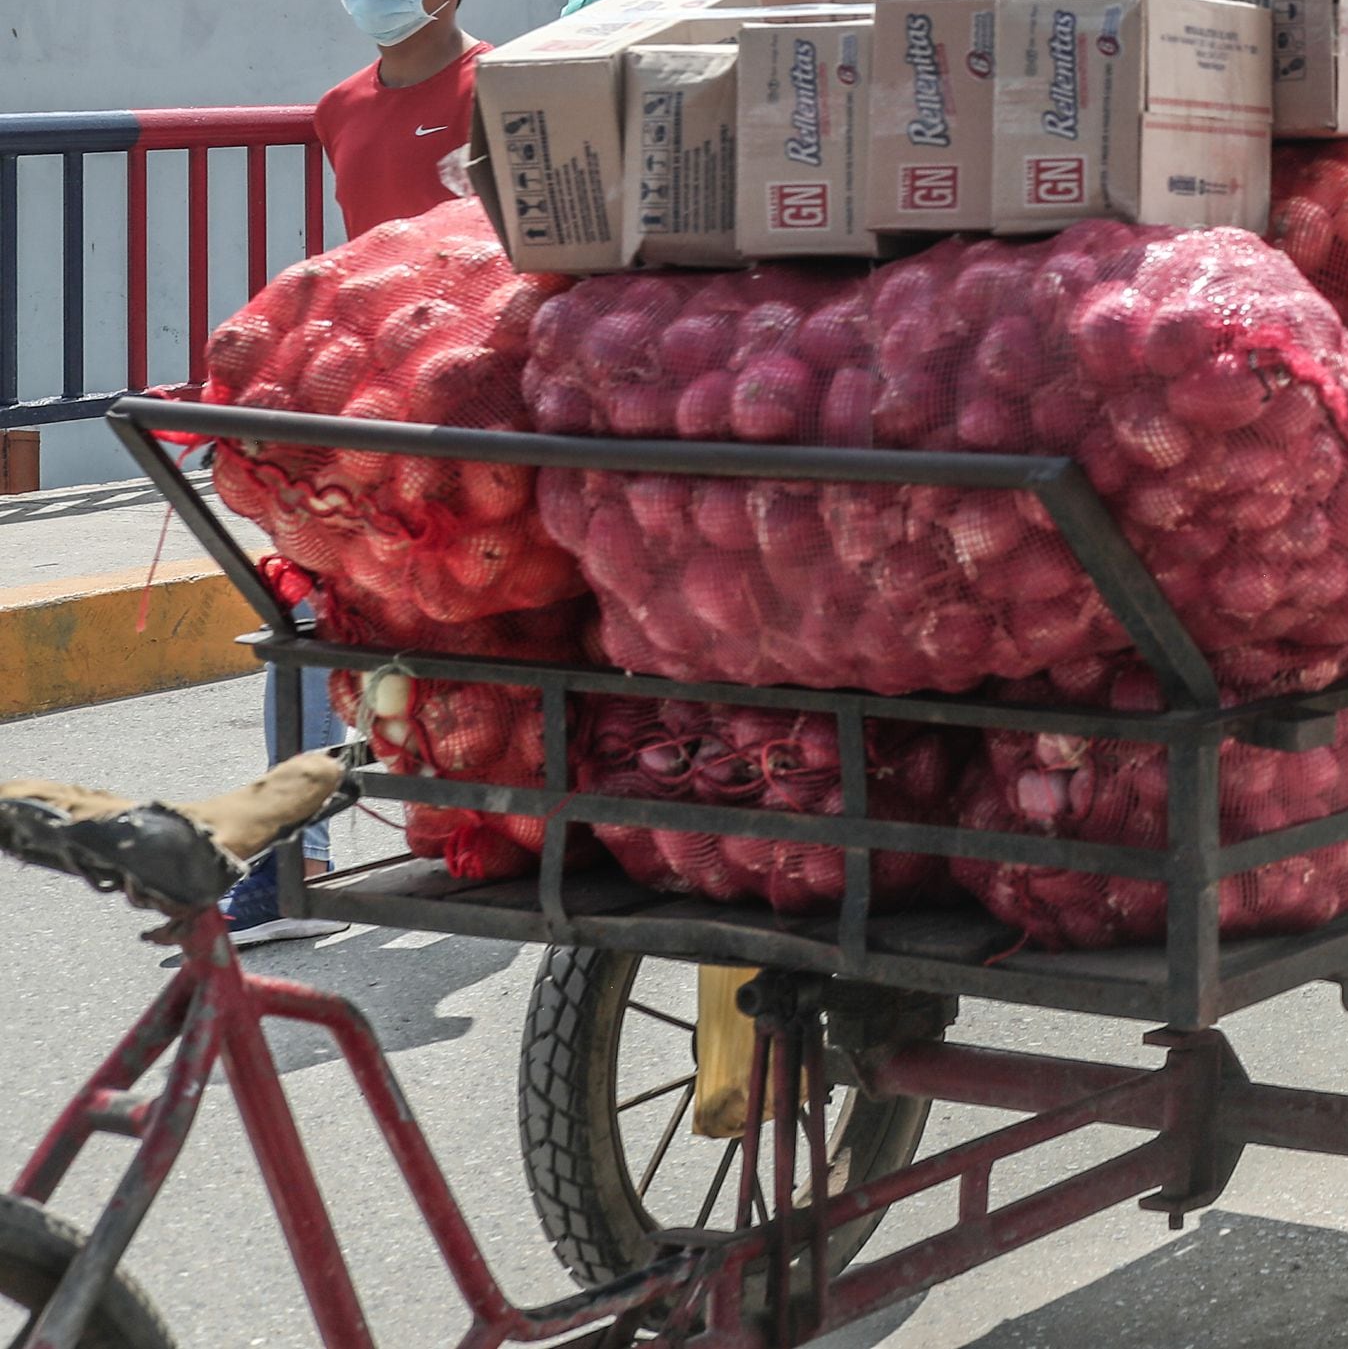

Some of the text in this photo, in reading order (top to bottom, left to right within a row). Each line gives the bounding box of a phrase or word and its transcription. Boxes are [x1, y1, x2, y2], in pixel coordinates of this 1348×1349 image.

[786, 39, 821, 167] Rellenitas
[907, 13, 950, 148] Rellenitas
[1043, 9, 1078, 141] Rellenitas
[782, 185, 824, 228] GN
[912, 167, 955, 208] GN
[1038, 160, 1081, 203] GN
